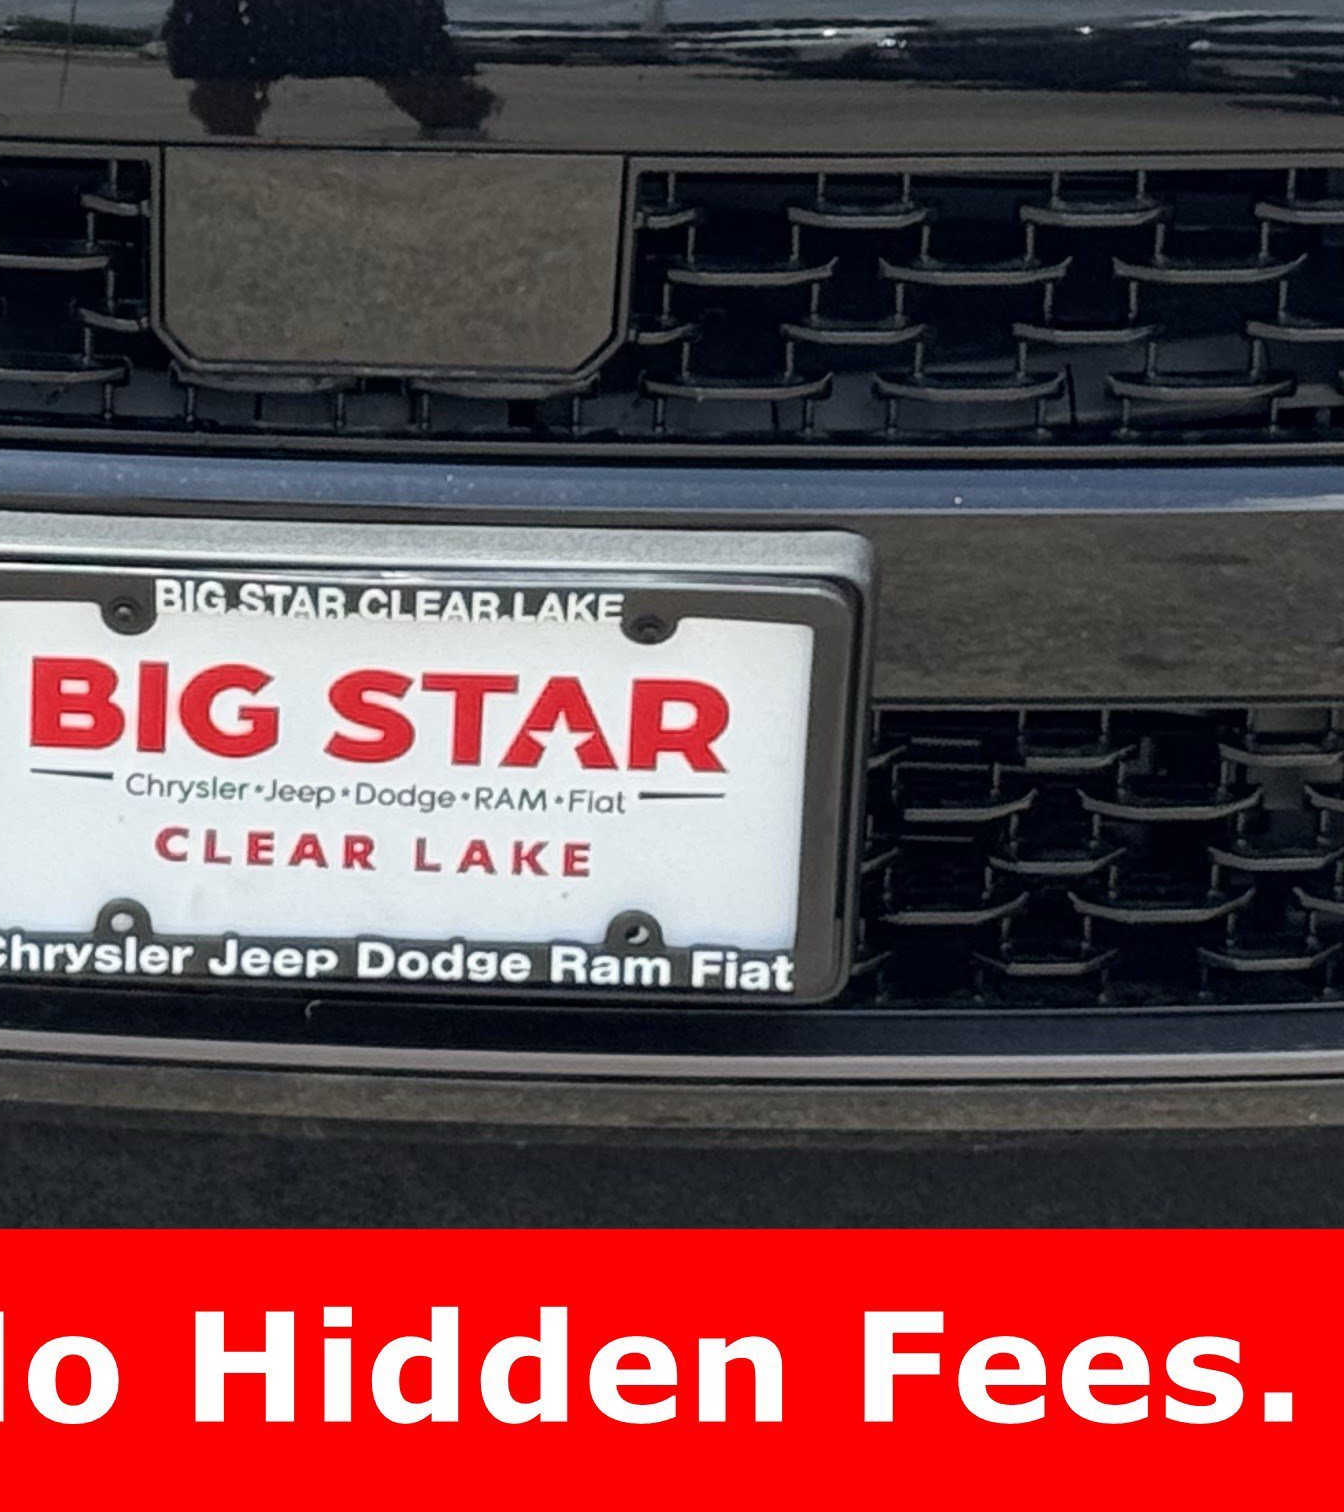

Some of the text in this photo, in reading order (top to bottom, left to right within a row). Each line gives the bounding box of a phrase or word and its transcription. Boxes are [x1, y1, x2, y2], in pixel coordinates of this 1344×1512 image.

[155, 579, 625, 624] BIG STAR CLEAR LAKE
[30, 656, 728, 773] BIG STAR
[125, 772, 248, 803] Chrysler
[264, 779, 336, 807] Jeep
[355, 782, 456, 813] Dodge
[475, 788, 548, 812] RAM
[154, 826, 592, 878] CLEAR LAKE
[208, 939, 339, 978] Jeep
[356, 942, 532, 982] Dodge
[551, 945, 672, 987] Ram
[691, 951, 795, 991] Fiat
